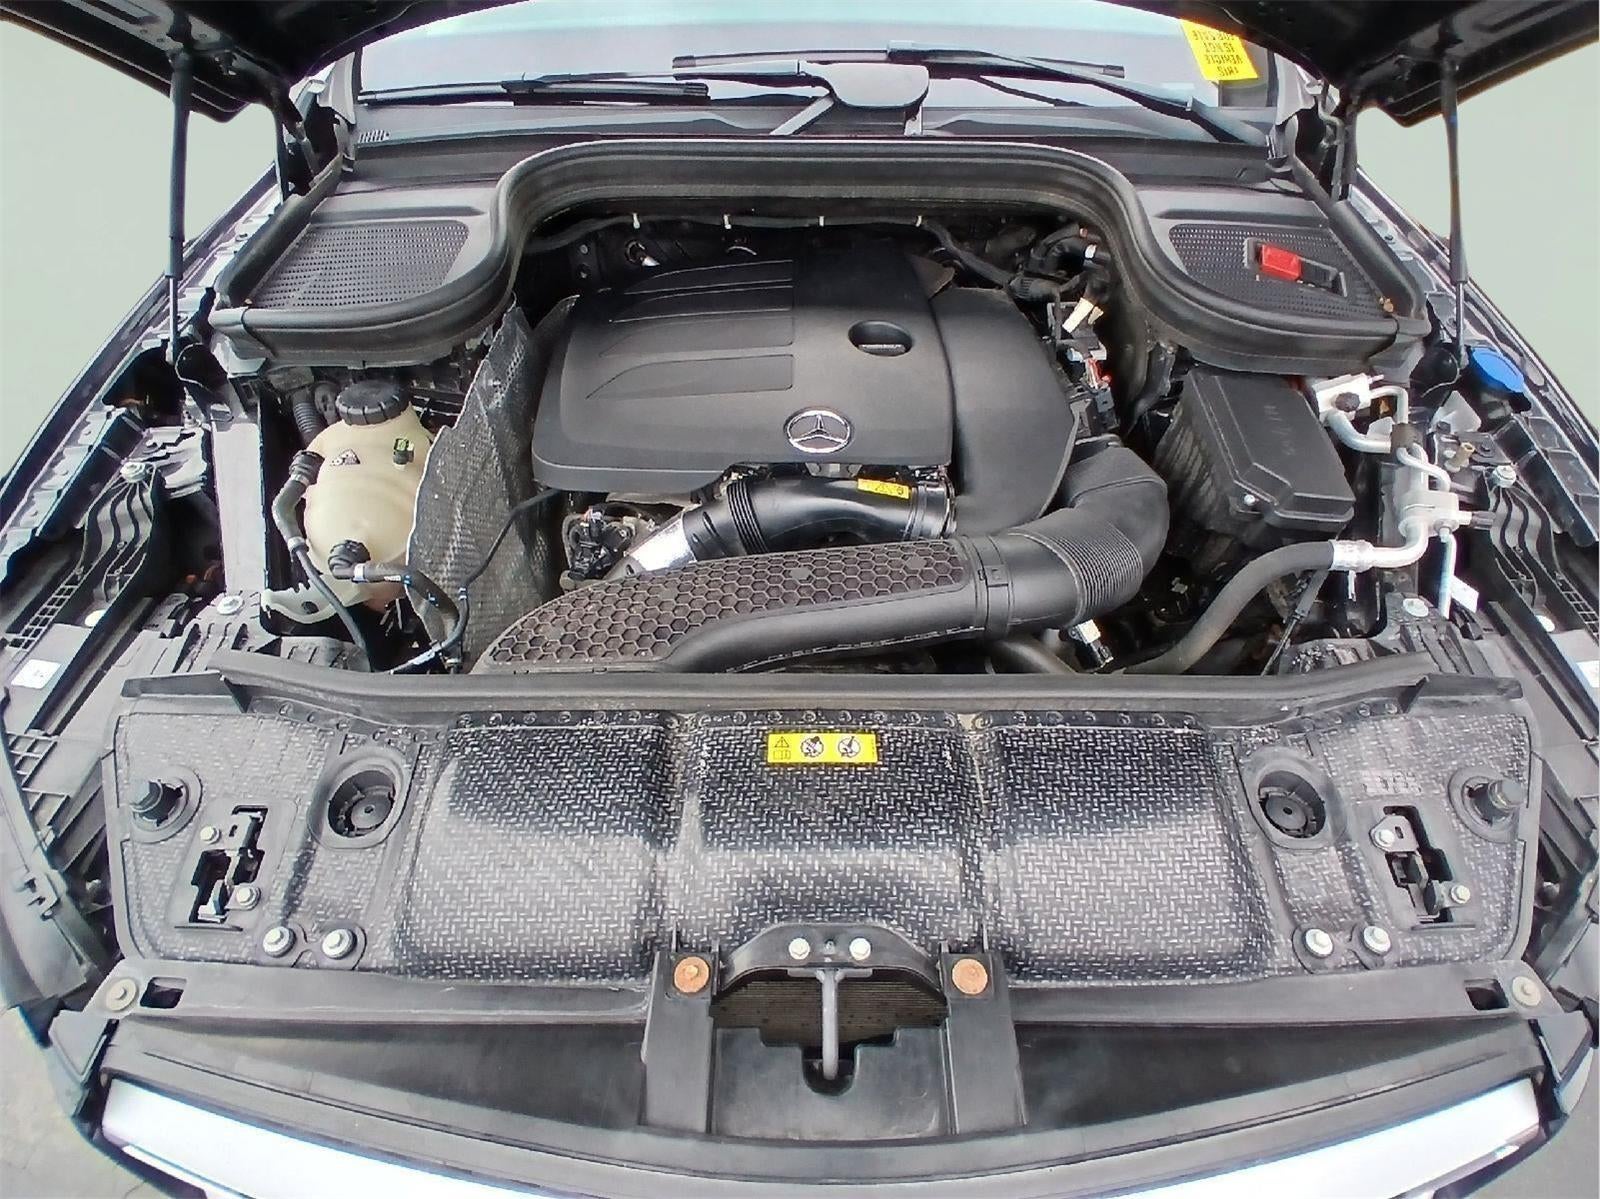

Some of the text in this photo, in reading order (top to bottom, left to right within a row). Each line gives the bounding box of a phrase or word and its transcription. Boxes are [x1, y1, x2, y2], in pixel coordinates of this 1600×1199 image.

[1202, 42, 1236, 53] IS NOT
[1204, 54, 1244, 65] VEHICLE
[1216, 66, 1239, 77] THIS
